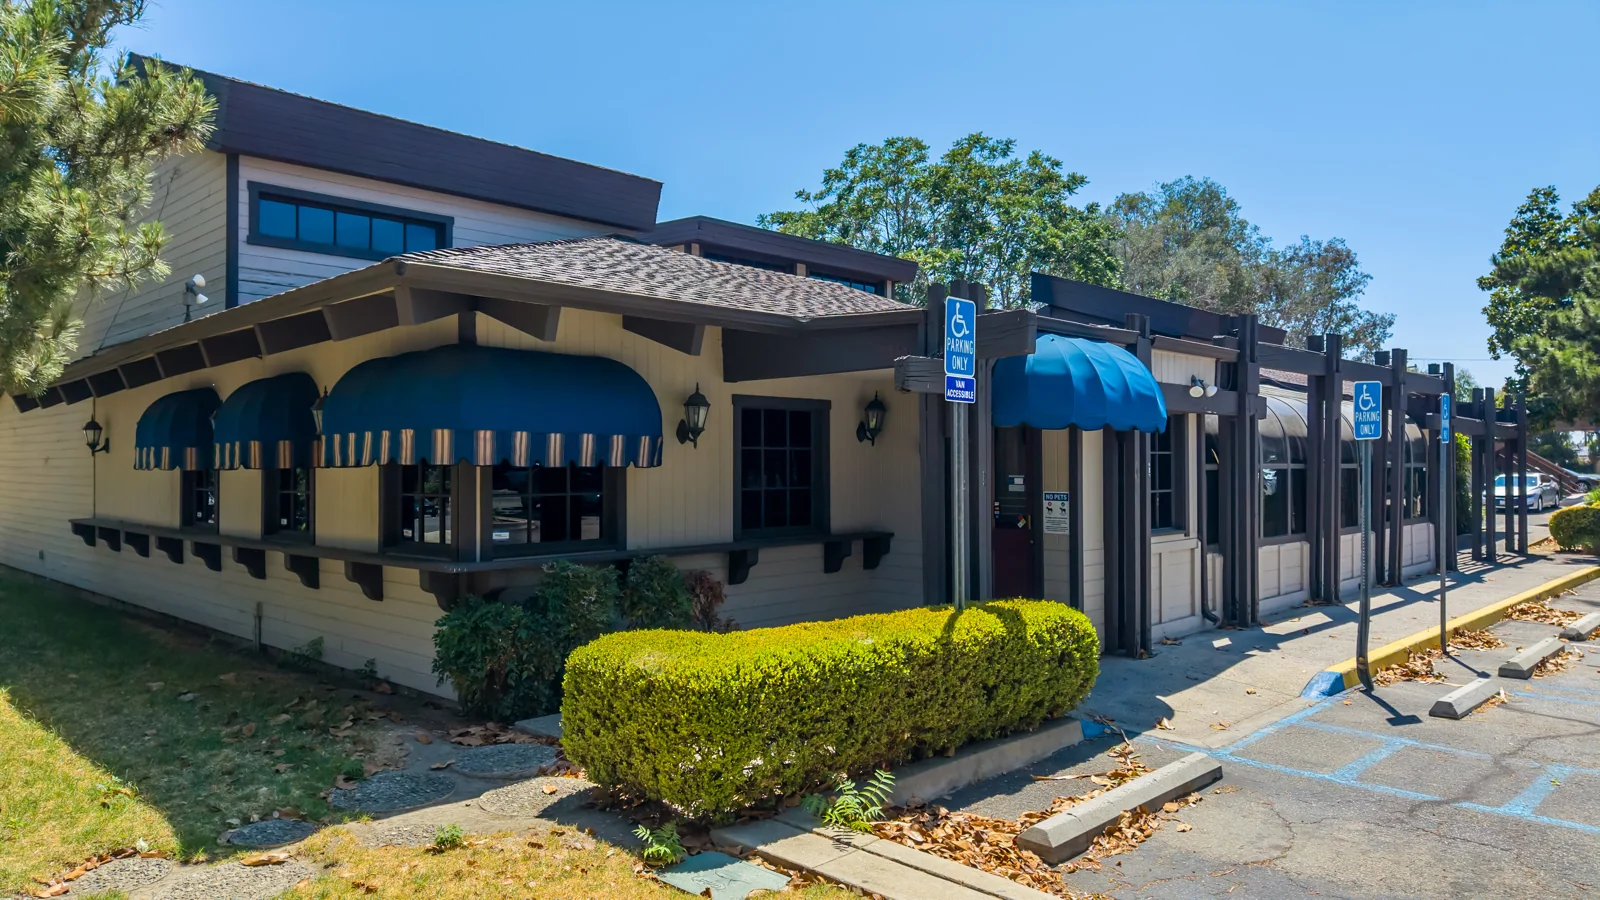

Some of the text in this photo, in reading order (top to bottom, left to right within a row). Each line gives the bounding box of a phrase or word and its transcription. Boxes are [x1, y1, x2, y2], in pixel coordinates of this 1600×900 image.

[947, 337, 974, 355] PARKING
[952, 355, 969, 371] ONLY
[955, 380, 965, 389] VAN
[947, 389, 974, 399] ACCESSIBLE
[1355, 411, 1380, 422] PARKING
[1360, 424, 1375, 435] ONLY
